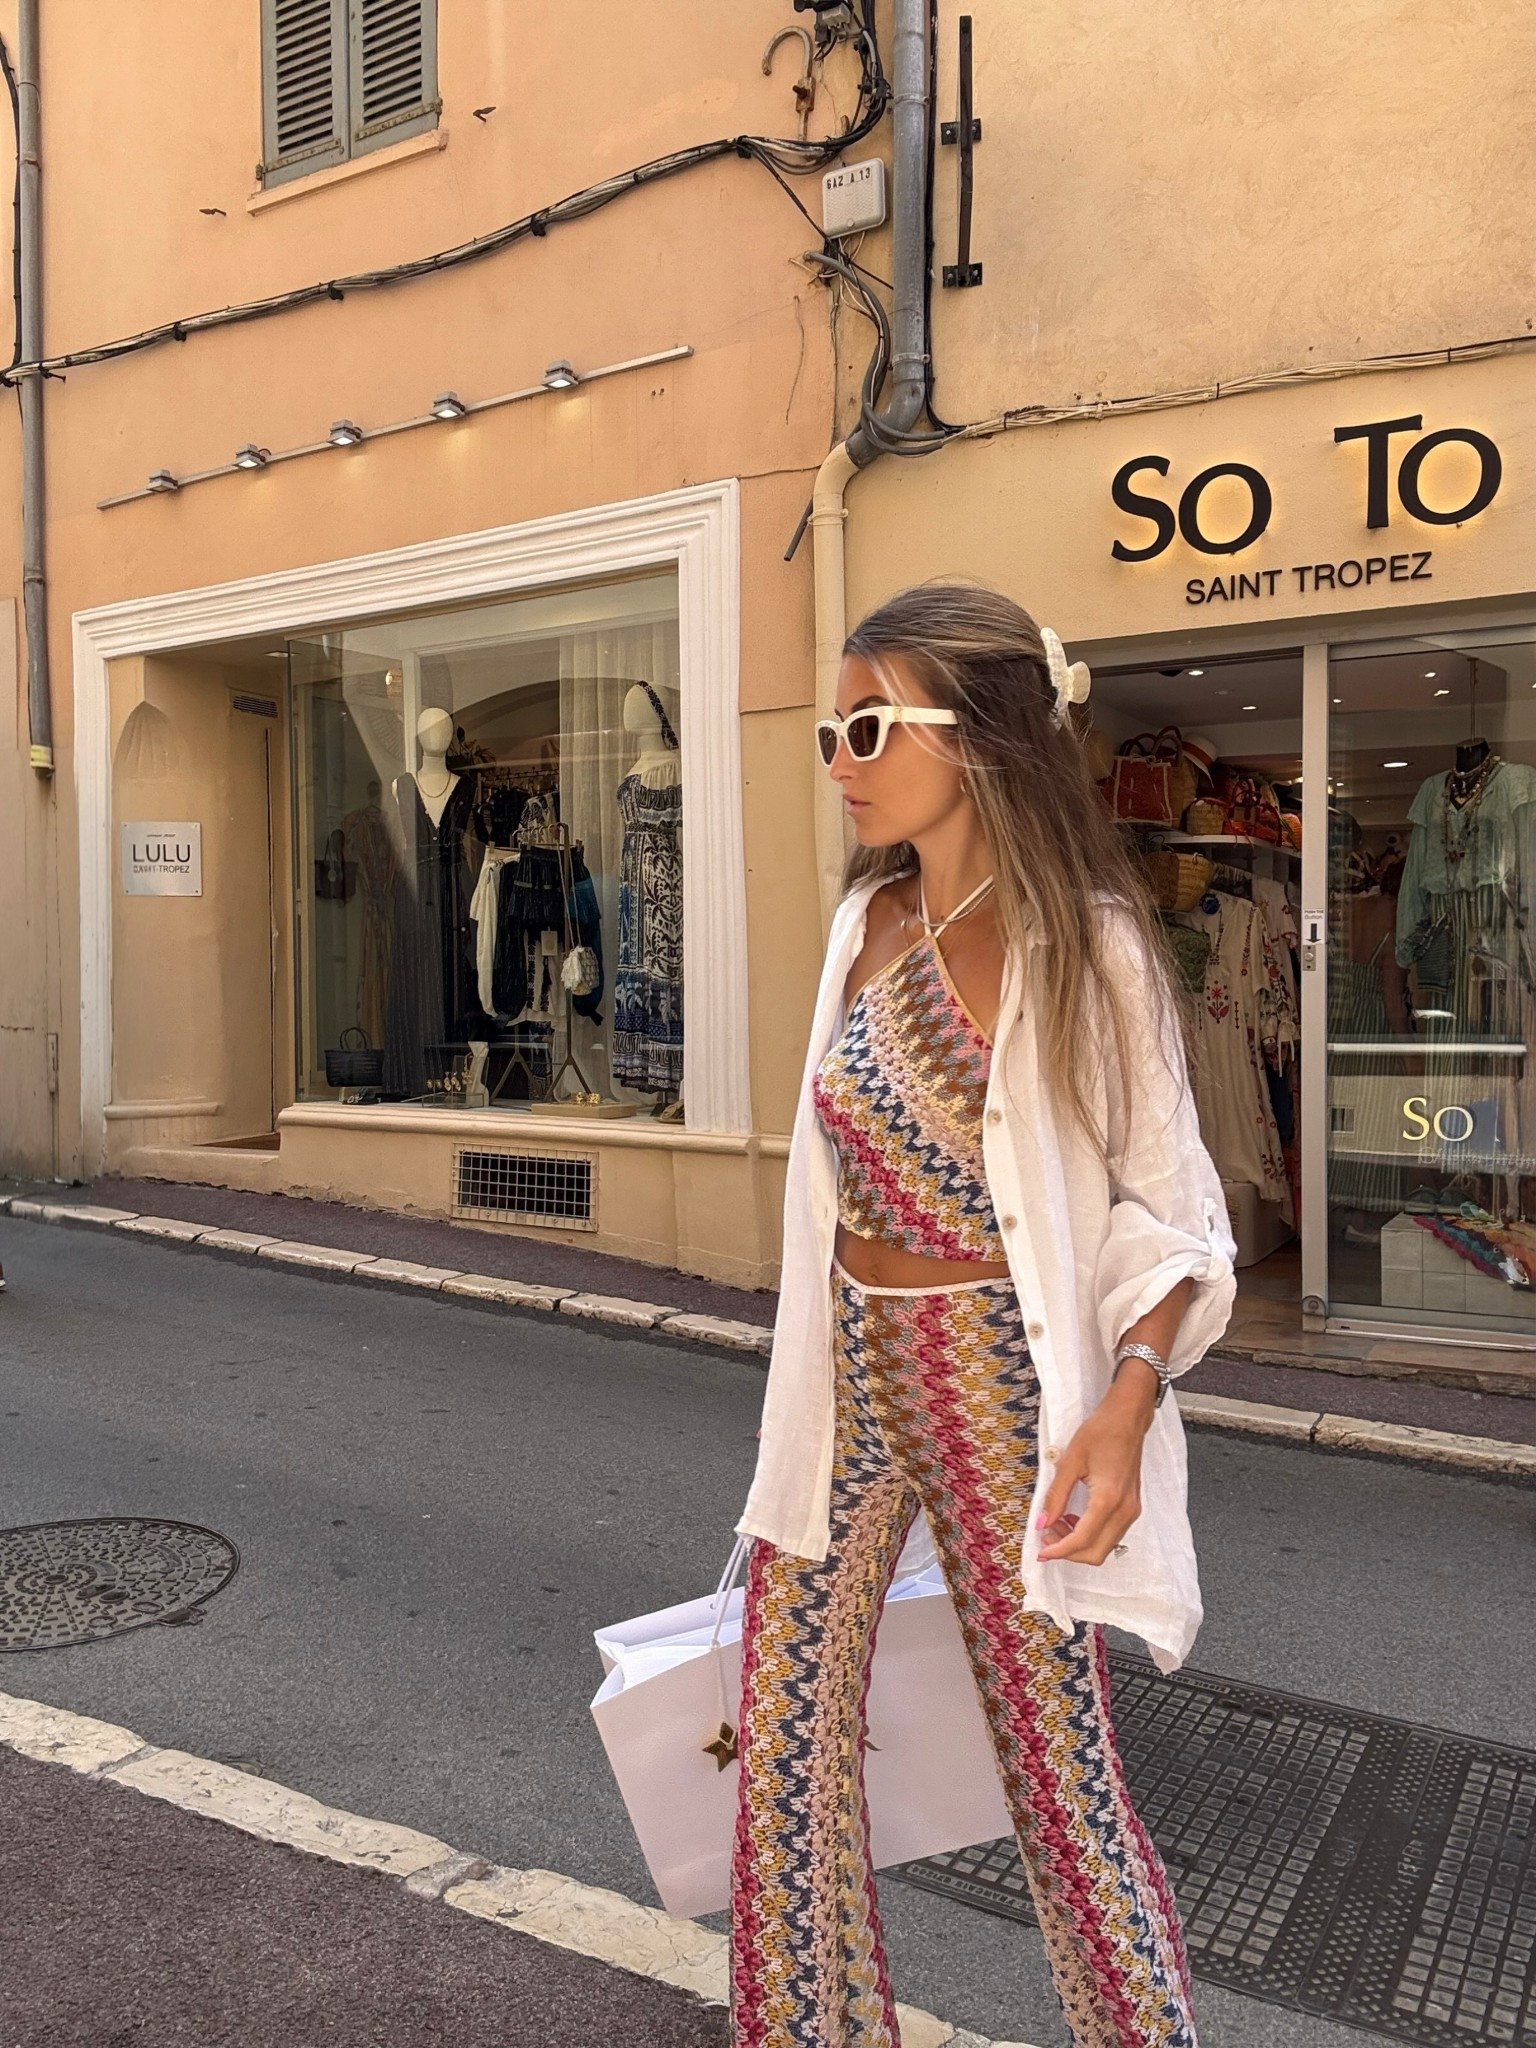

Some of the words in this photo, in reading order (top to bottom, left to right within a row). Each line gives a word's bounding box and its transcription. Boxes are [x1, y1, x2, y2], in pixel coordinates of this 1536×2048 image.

[850, 172, 855, 183] A
[859, 167, 871, 181] 13
[1185, 569, 1284, 606] SAINT
[1292, 551, 1434, 593] TROPEZ
[133, 844, 190, 863] LULU
